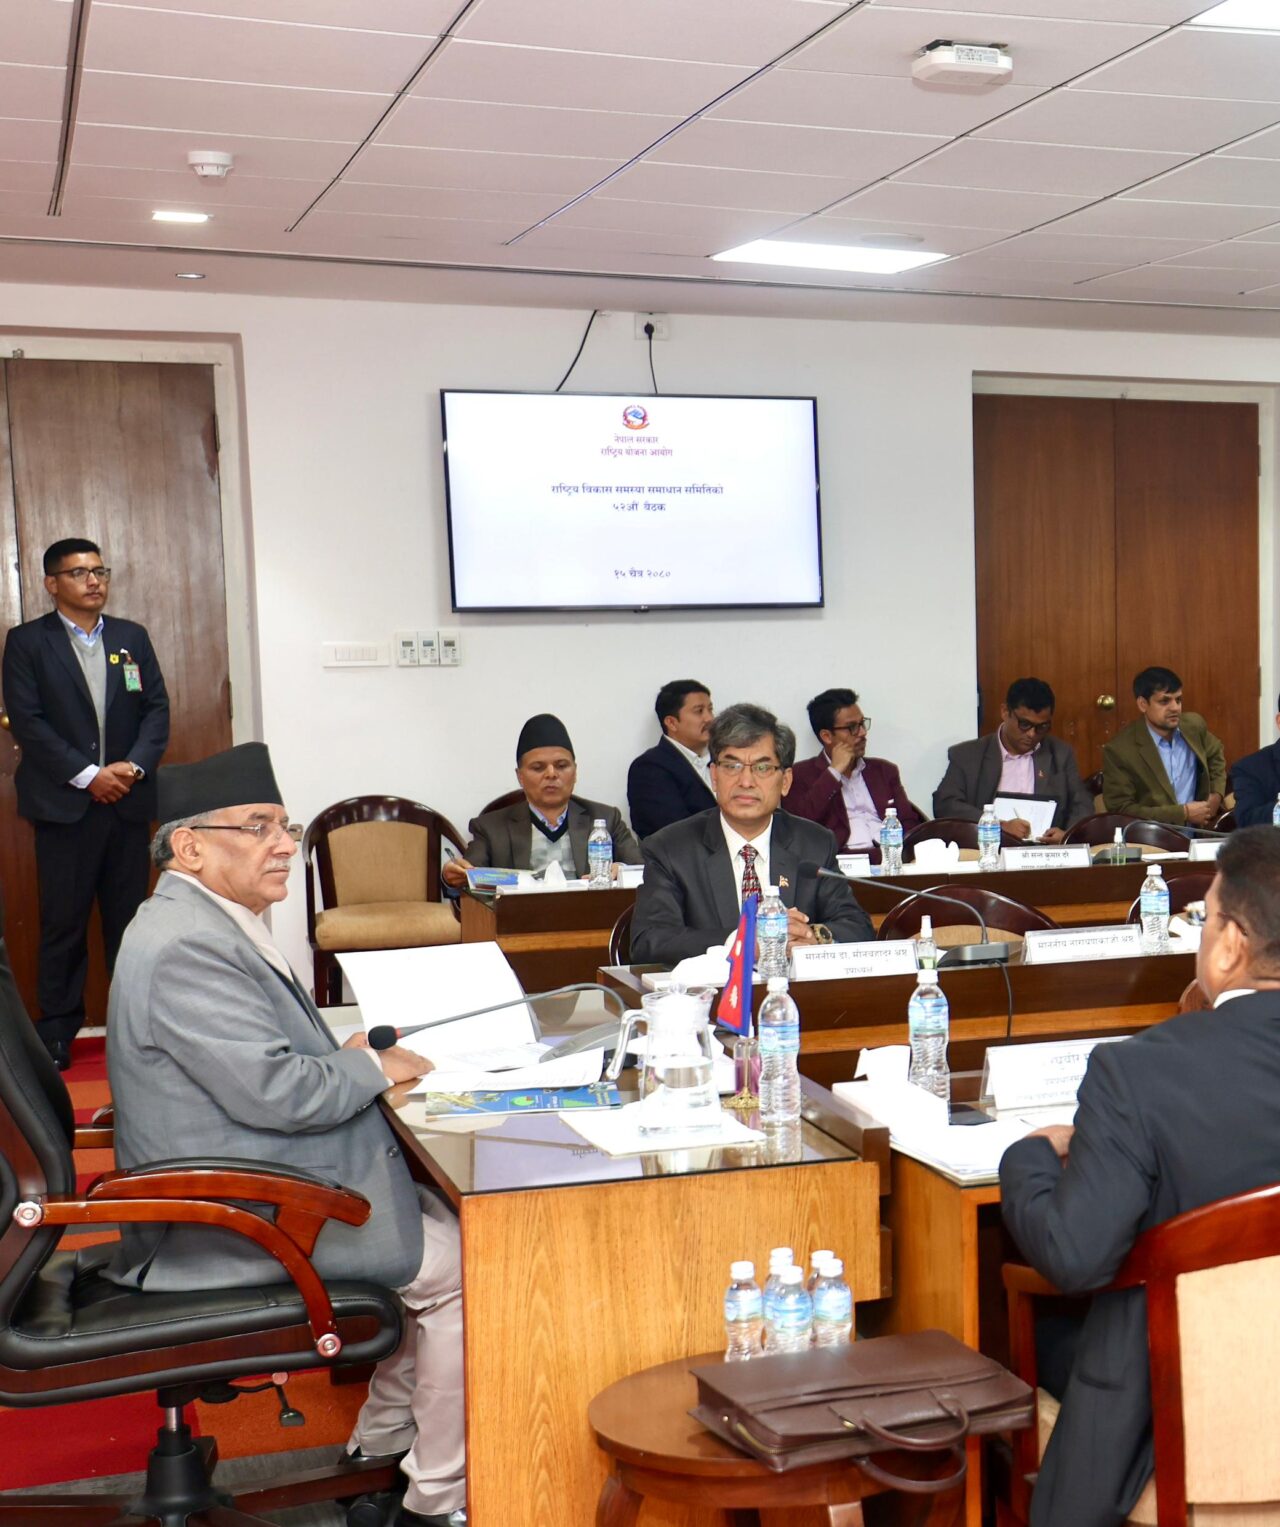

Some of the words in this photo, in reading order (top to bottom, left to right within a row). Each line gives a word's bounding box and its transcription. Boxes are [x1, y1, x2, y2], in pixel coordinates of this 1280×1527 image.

[582, 482, 612, 495] विकास
[615, 485, 645, 495] समस्या
[647, 485, 682, 495] समाधान
[684, 482, 724, 495] समितिको
[805, 949, 836, 961] माननीय
